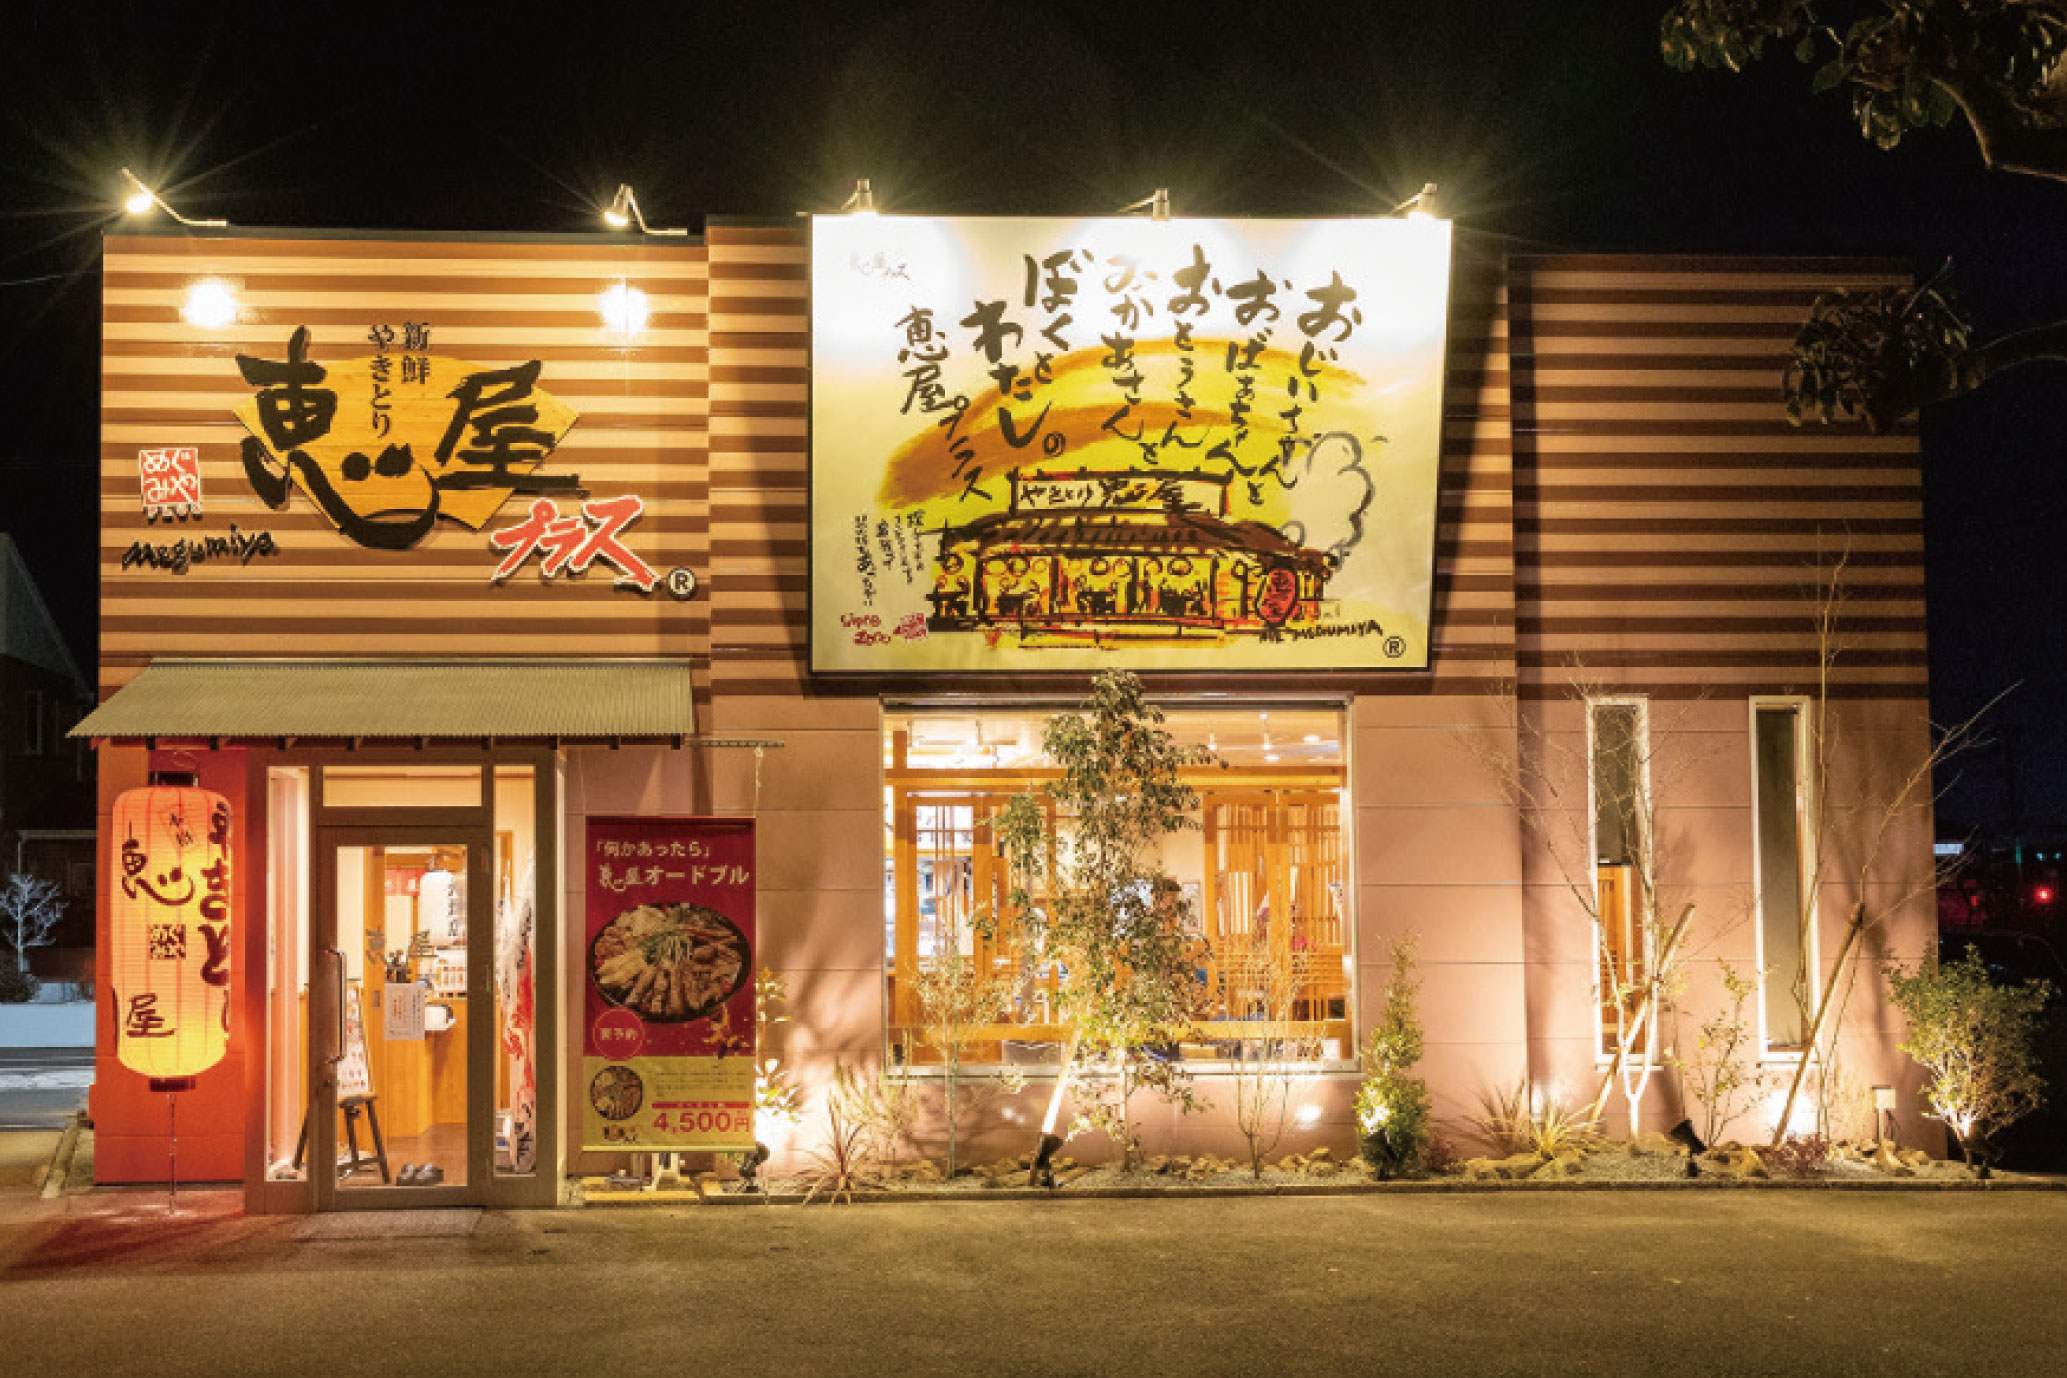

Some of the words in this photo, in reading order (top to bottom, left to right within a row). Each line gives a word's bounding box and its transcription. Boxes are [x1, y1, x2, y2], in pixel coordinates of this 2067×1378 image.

[368, 324, 394, 439] やきとり
[403, 322, 430, 385] 新鮮
[491, 496, 660, 593] プラス
[198, 802, 229, 1034] やきと
[653, 1112, 750, 1135] 4,500円
